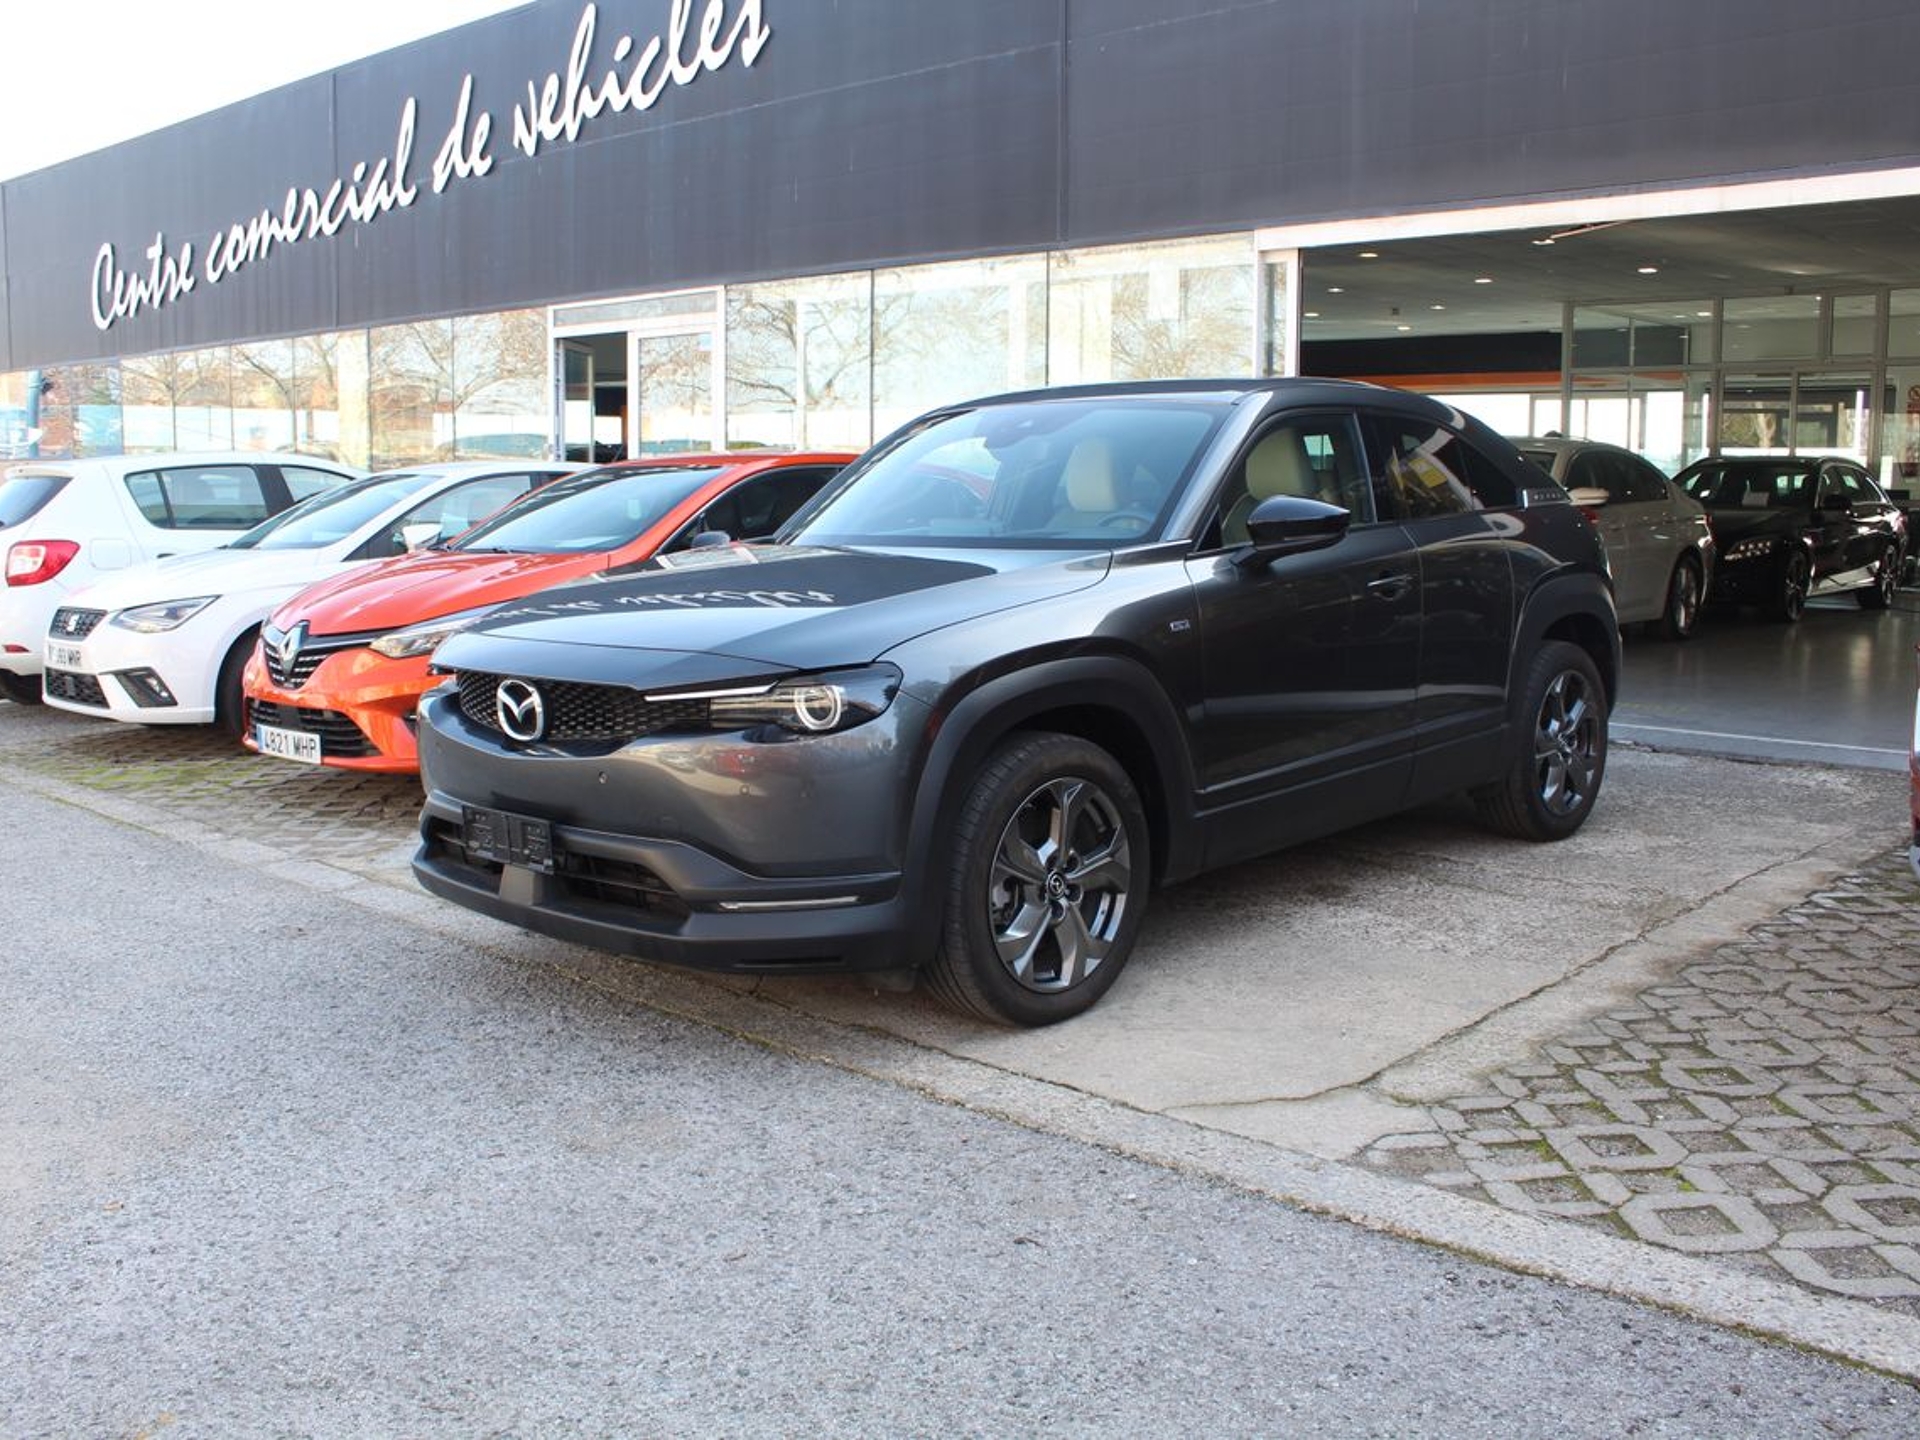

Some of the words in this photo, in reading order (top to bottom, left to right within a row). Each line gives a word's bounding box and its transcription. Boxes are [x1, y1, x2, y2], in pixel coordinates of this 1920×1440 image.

[91, 231, 196, 331] Centre
[205, 97, 417, 284] comercial
[432, 73, 493, 194] de
[512, 0, 771, 157] vehicles
